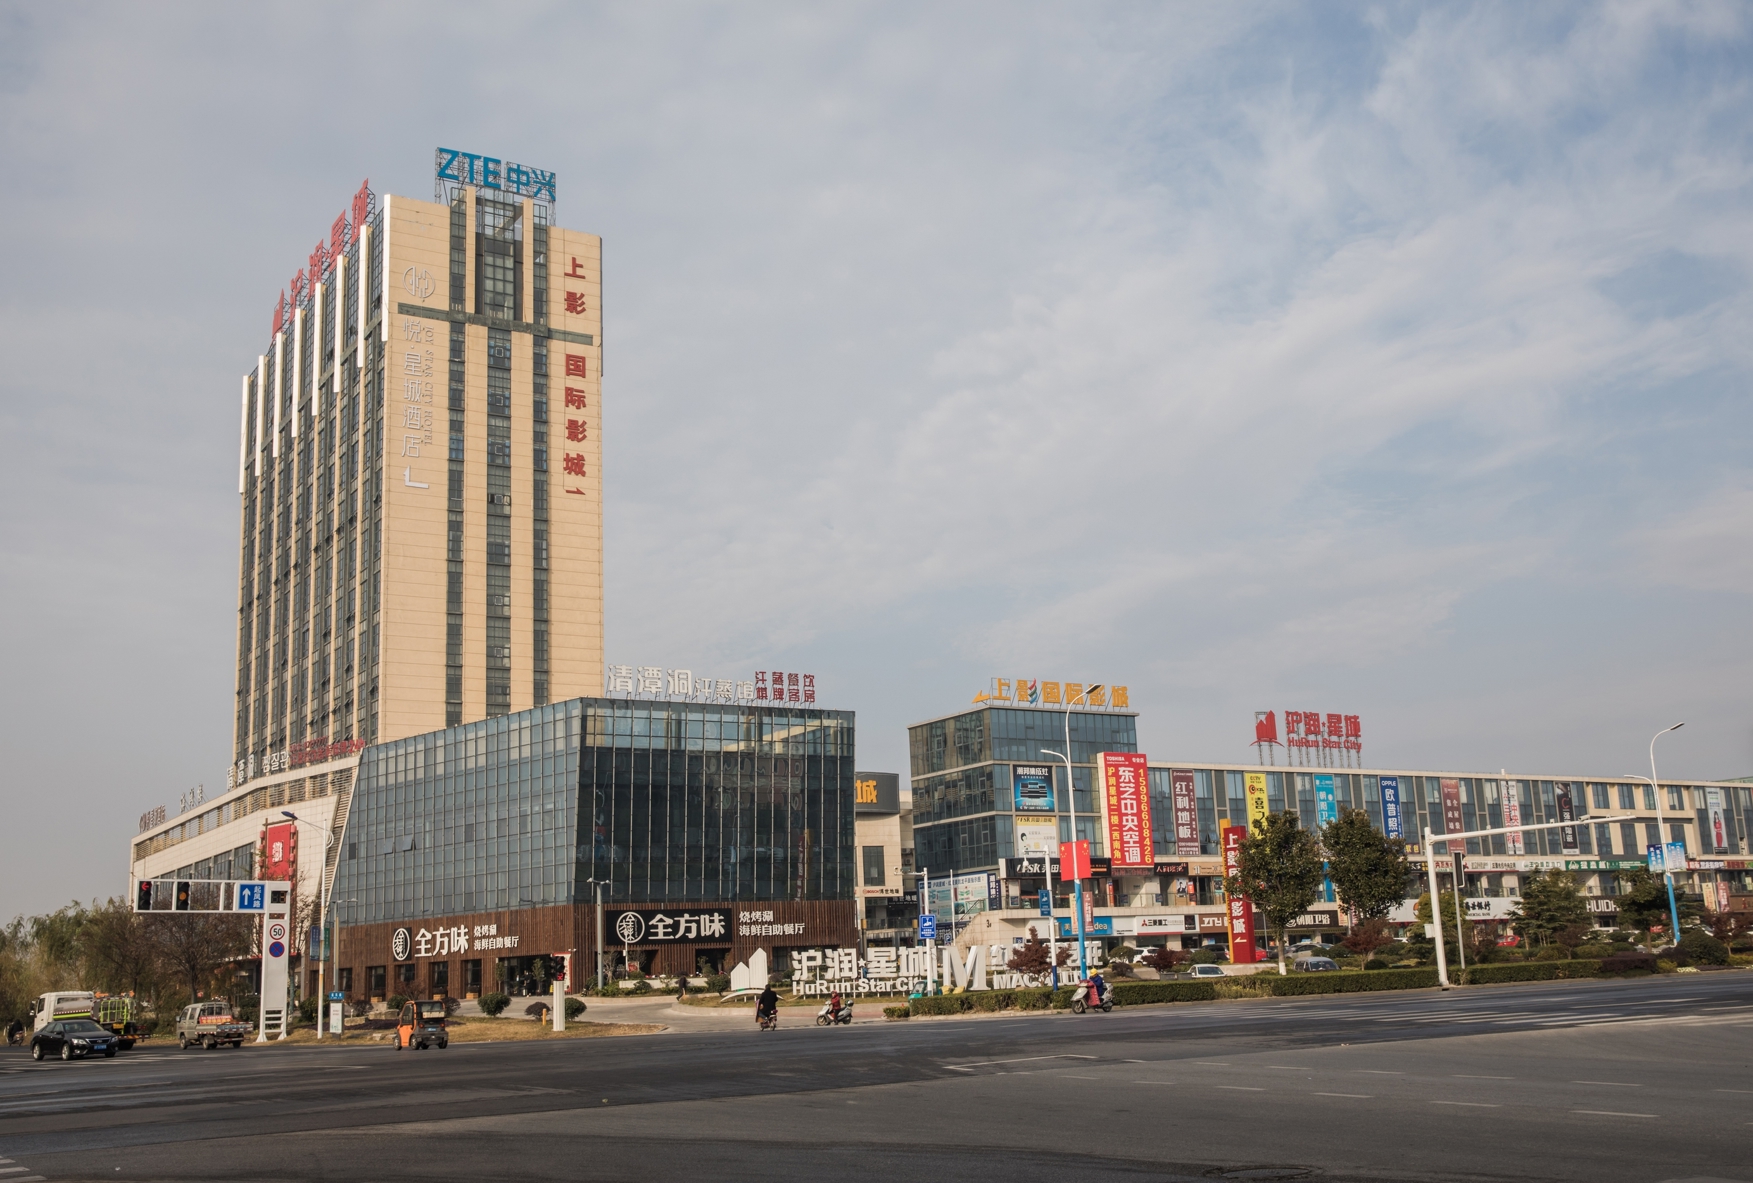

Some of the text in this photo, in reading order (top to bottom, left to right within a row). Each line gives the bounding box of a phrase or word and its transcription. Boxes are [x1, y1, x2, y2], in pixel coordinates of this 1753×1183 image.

[438, 147, 556, 201] ZTE 中兴
[564, 256, 587, 478] 上影国际影城
[423, 325, 434, 447] JOY STAR CITY HOTEL
[992, 677, 1129, 708] 上影国际影城
[1287, 737, 1362, 753] HuRun Star City
[1118, 766, 1141, 863] 东芝中央空调
[1138, 768, 1152, 864] 15996608426
[1175, 781, 1191, 838] 红利地板
[1226, 833, 1246, 934] 上影国影城
[273, 928, 282, 936] 50
[414, 924, 470, 957] 全方味
[648, 912, 725, 940] 全方味
[739, 923, 805, 937] 海鲜自助餐厅
[473, 935, 520, 951] 海鲜自助餐厅
[792, 980, 850, 995] HuRun
[858, 978, 893, 992] Star
